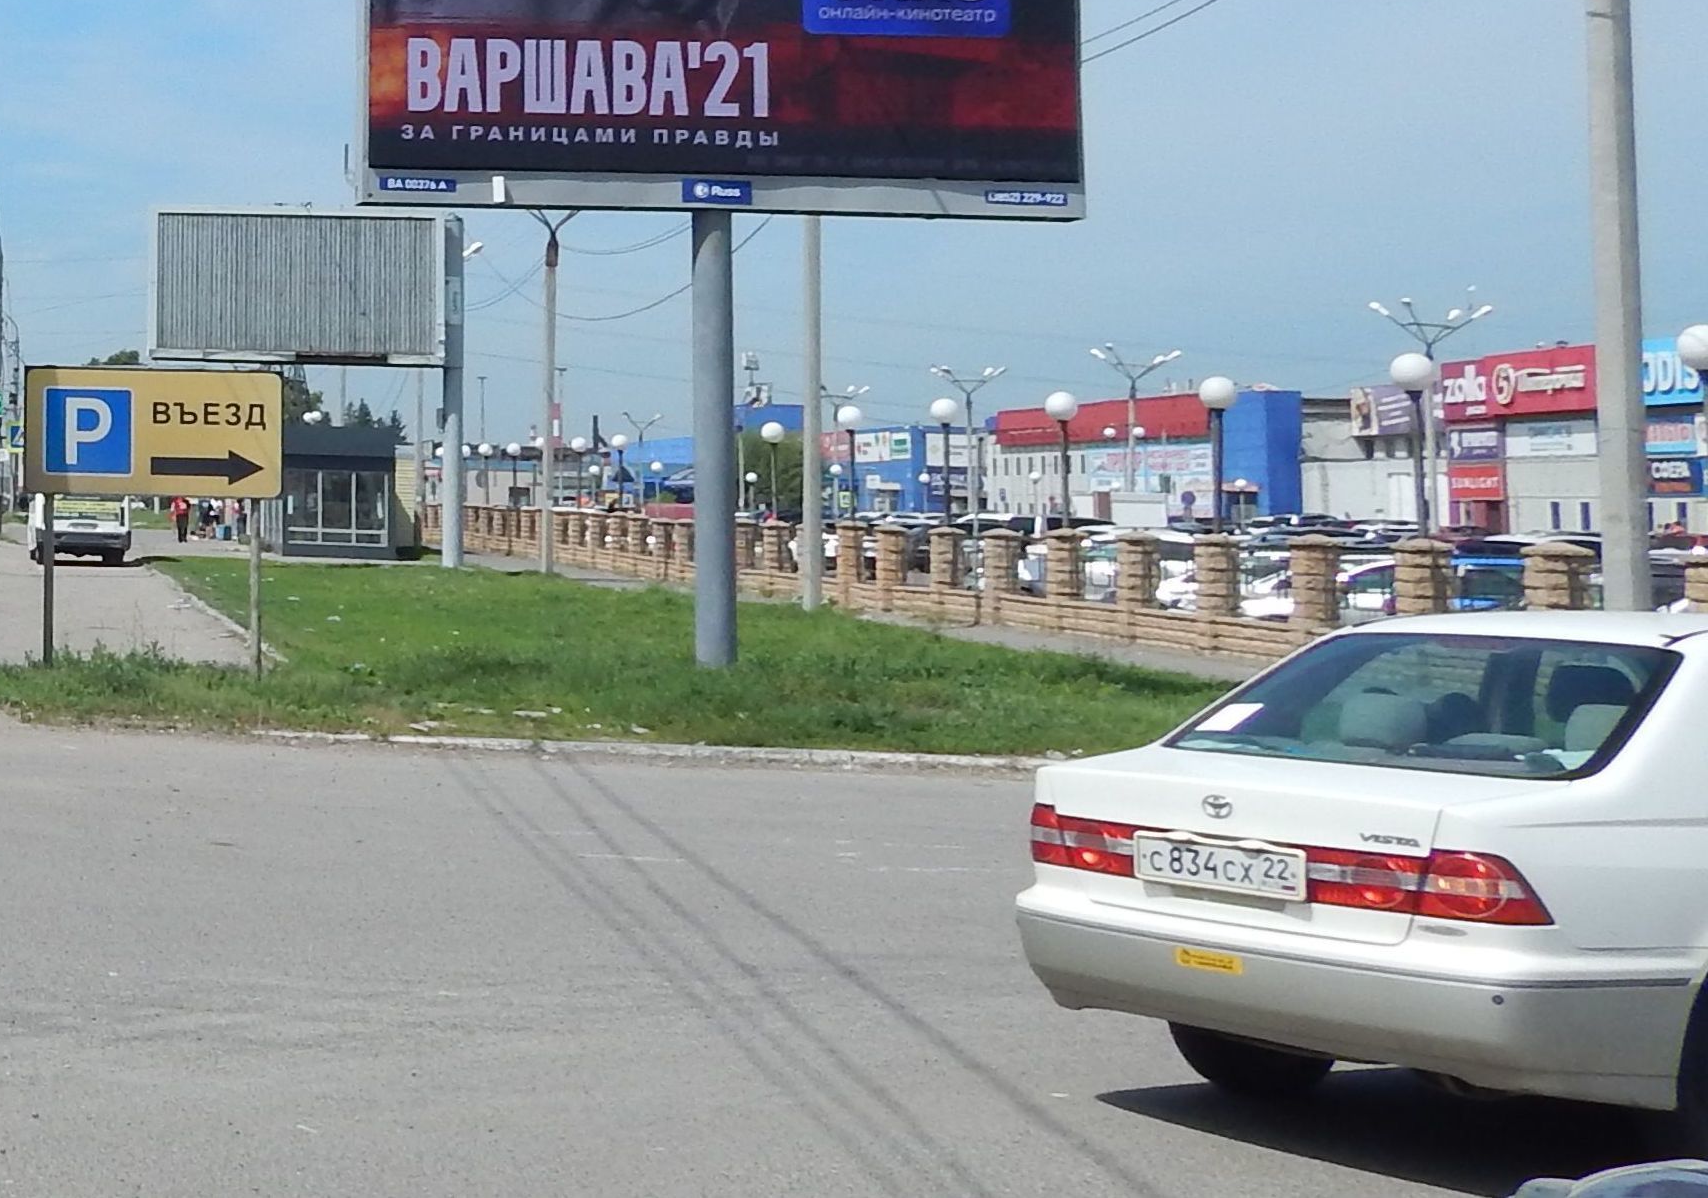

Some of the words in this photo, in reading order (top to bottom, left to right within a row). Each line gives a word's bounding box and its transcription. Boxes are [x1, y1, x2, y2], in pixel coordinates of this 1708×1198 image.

[818, 4, 997, 22] онлайн-кинотеатр
[407, 37, 769, 118] ВАРШАВА'21
[401, 124, 435, 140] ЗА
[452, 125, 637, 145] ГРАНИЦАМИ
[653, 129, 780, 149] ПРАВДЫ
[151, 401, 266, 431] ВЪЕЗД
[1263, 856, 1290, 882] 22
